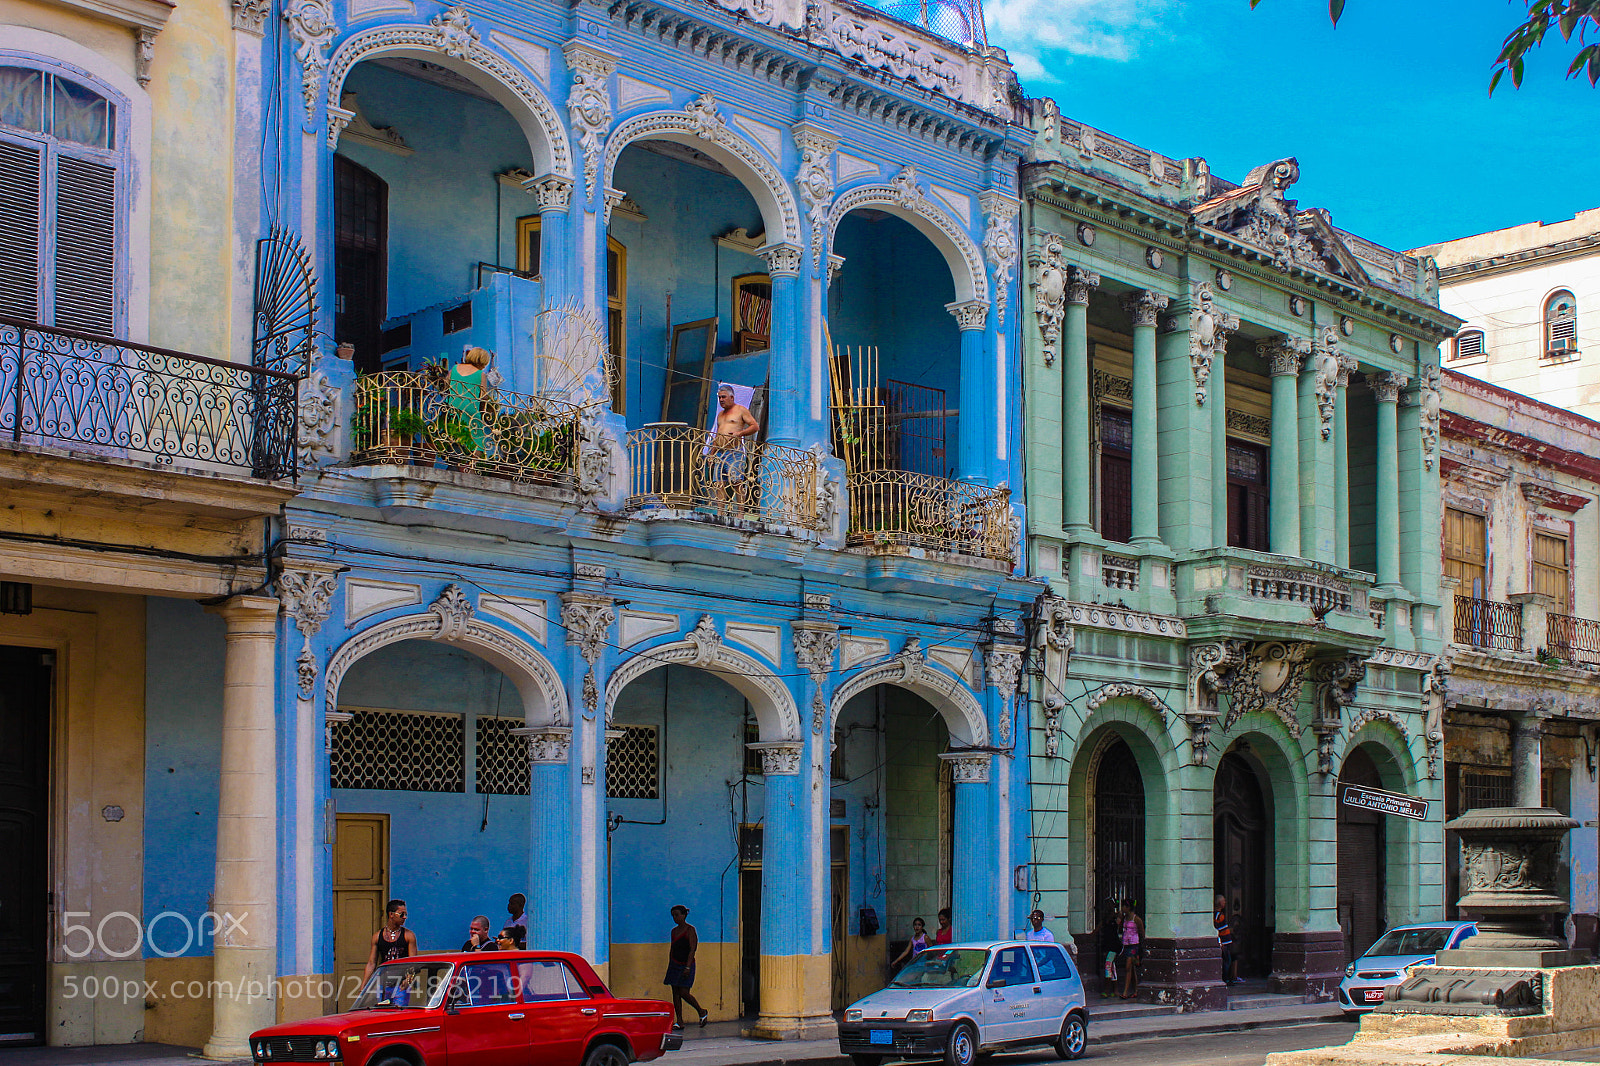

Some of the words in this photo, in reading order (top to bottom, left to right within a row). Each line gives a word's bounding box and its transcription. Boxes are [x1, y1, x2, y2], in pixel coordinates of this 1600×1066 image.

[1346, 796, 1366, 805] JULIO
[1367, 800, 1398, 811] ANTONIO
[1399, 807, 1422, 816] MELLA
[1361, 793, 1384, 802] Escuela
[1385, 798, 1411, 807] Primaria
